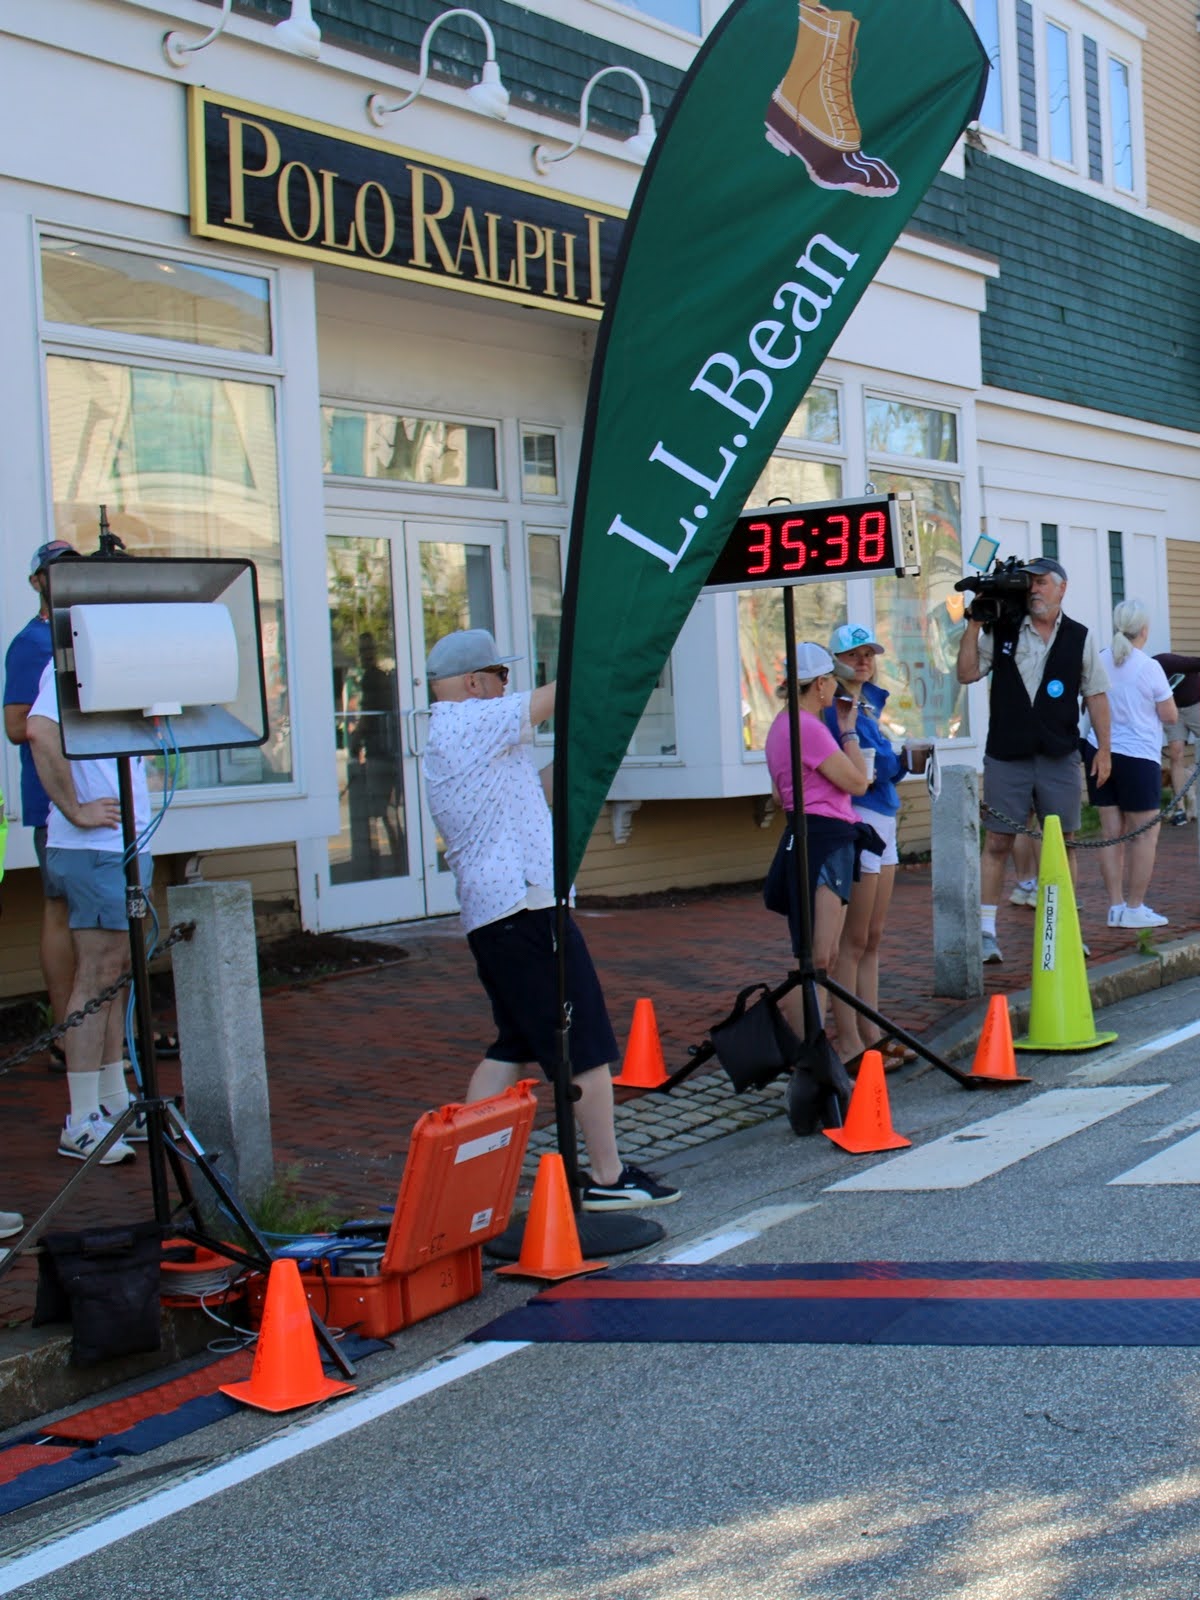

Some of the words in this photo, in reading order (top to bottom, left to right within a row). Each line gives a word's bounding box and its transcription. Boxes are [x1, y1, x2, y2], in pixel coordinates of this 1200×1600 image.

[607, 233, 860, 574] L.L.Bean
[747, 511, 886, 574] 35:38
[1045, 907, 1053, 940] BEAN
[1043, 945, 1051, 970] 10K
